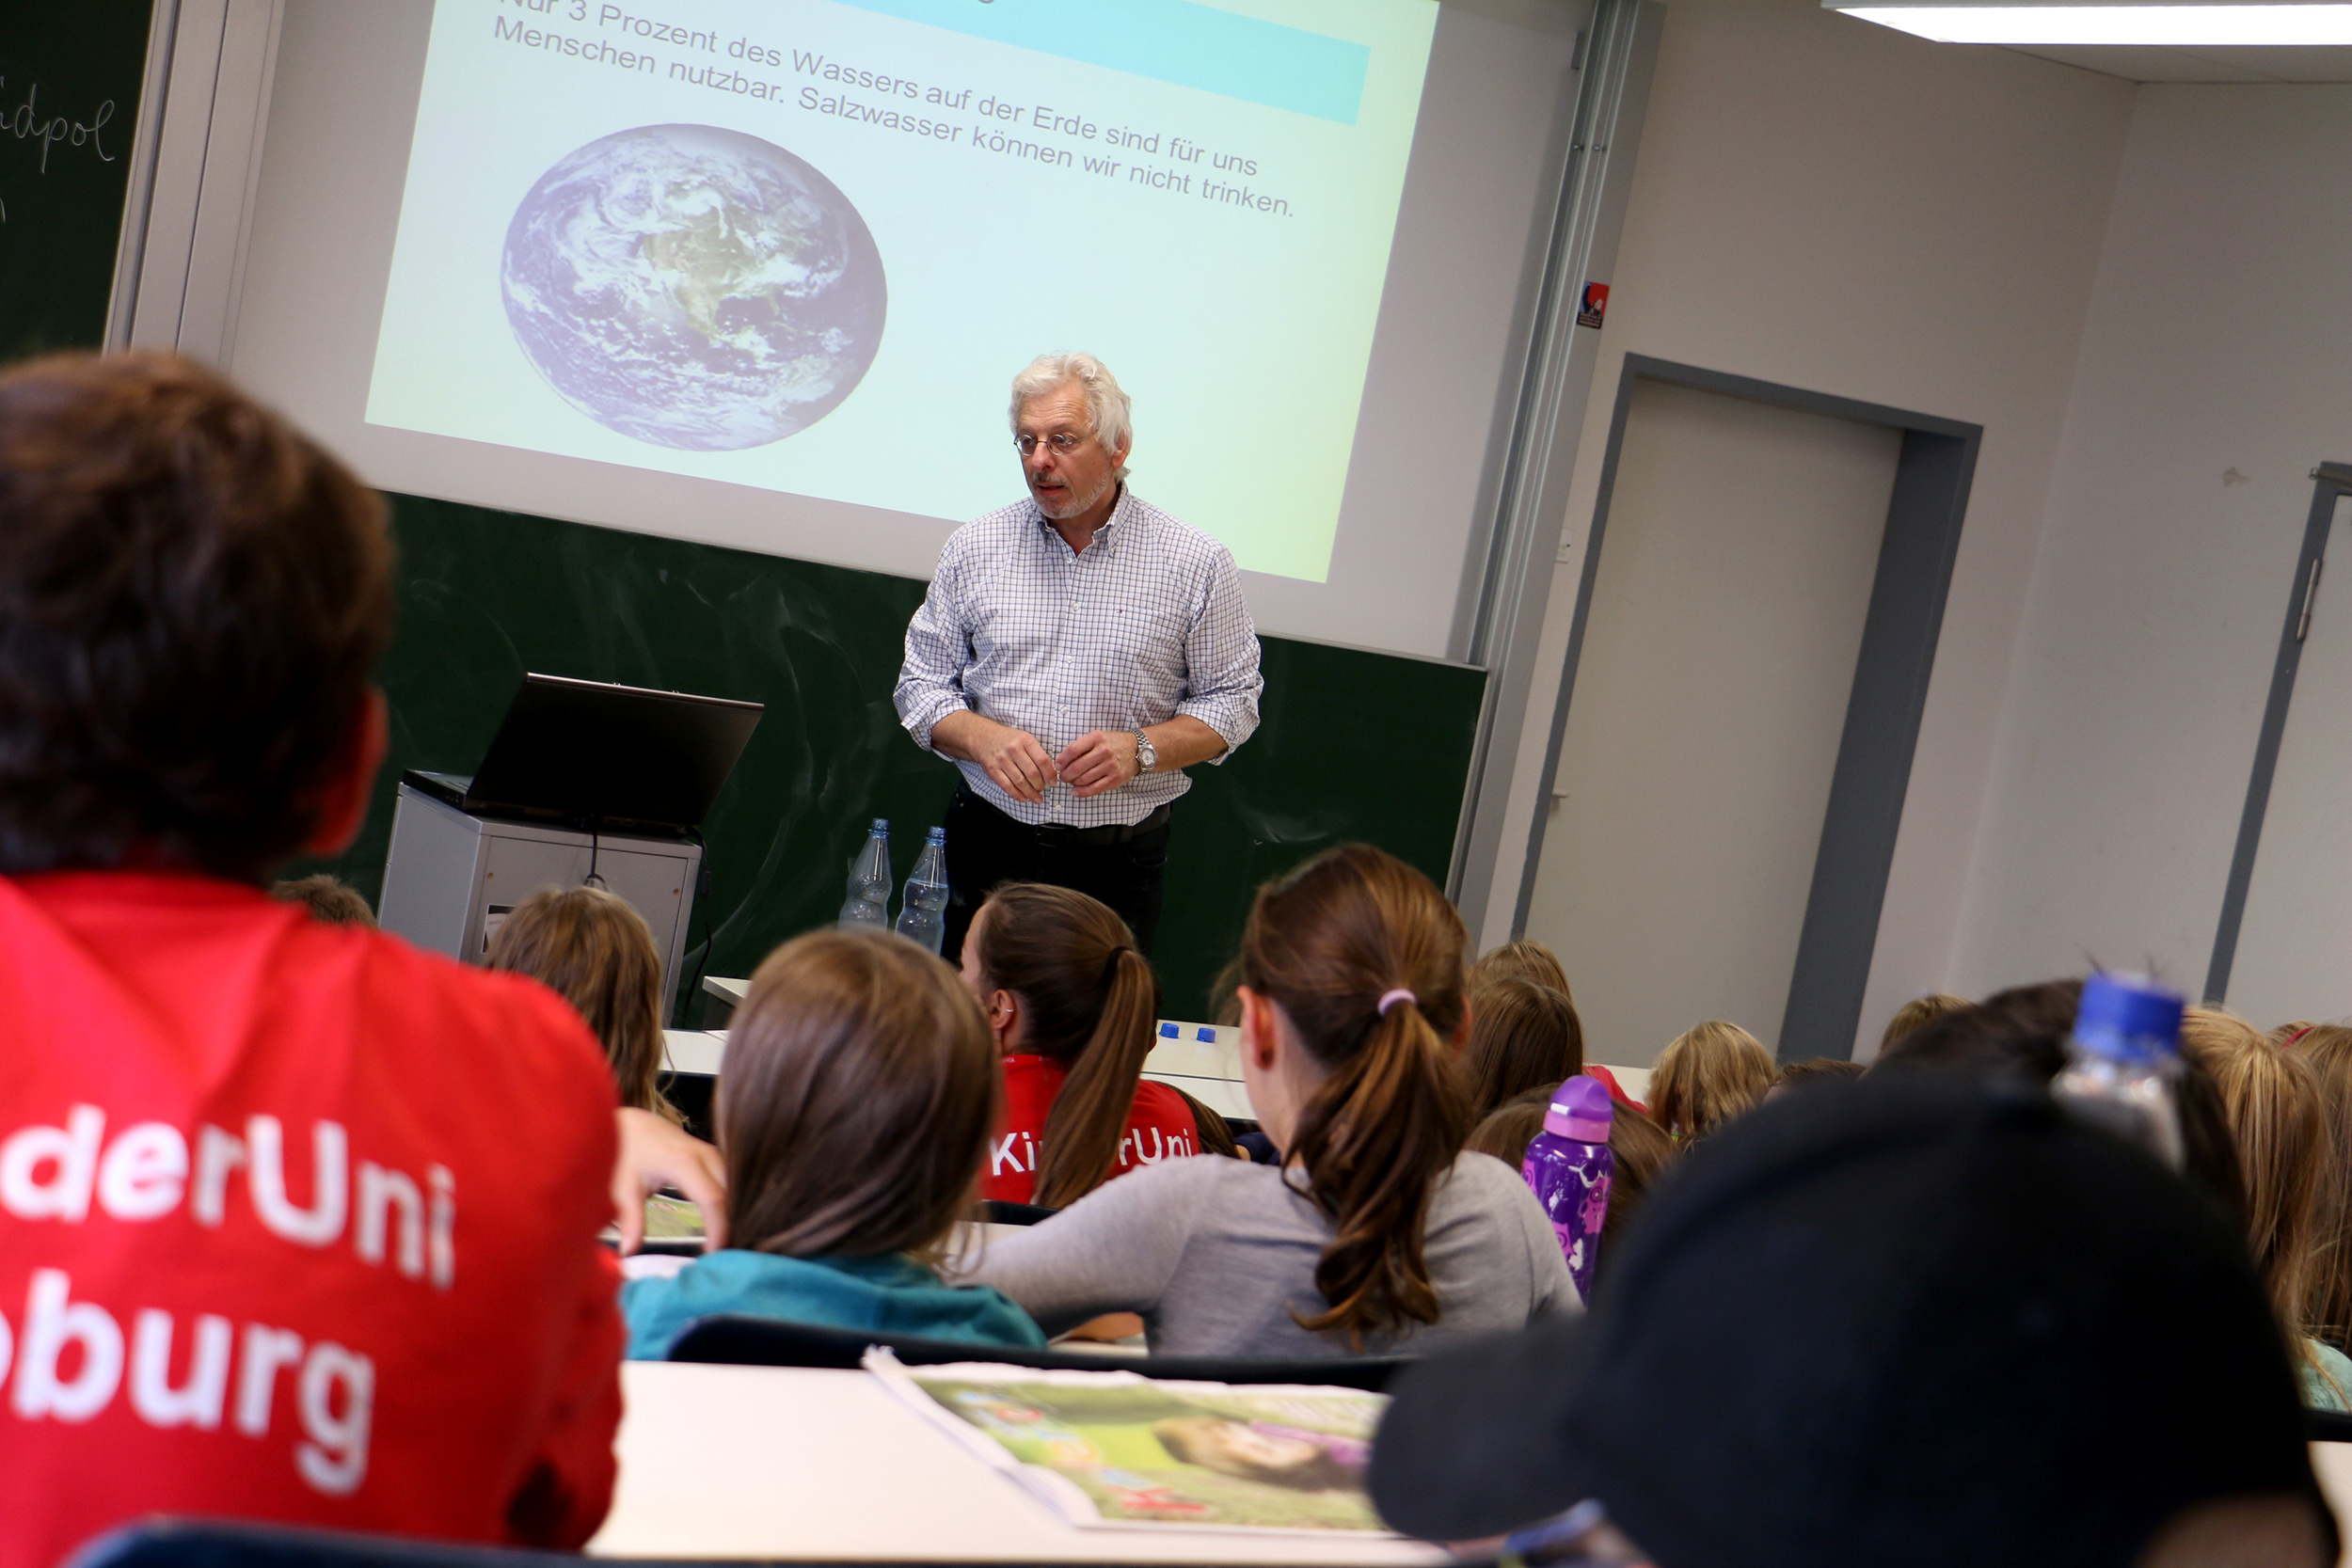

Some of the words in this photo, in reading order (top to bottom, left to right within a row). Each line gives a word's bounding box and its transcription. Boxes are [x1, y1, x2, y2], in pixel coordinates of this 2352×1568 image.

[495, 15, 655, 74] Menschen
[669, 62, 784, 103] nutzbar.
[799, 87, 962, 142] Salzwasser
[972, 126, 1073, 167] können
[1084, 155, 1121, 178] wir
[1130, 166, 1191, 195] nicht
[1202, 179, 1293, 217] trinken.
[500, 0, 559, 13] ur
[567, 0, 586, 21] 3
[599, 4, 719, 53] Prozent
[728, 38, 781, 67] des
[793, 49, 918, 99] Wassers
[926, 87, 973, 110] auf
[978, 95, 1025, 122] der
[1033, 105, 1097, 139] Erde
[1105, 126, 1160, 153] sind
[1169, 137, 1205, 164] für
[1213, 152, 1257, 176] uns
[0, 1267, 374, 1497] burg
